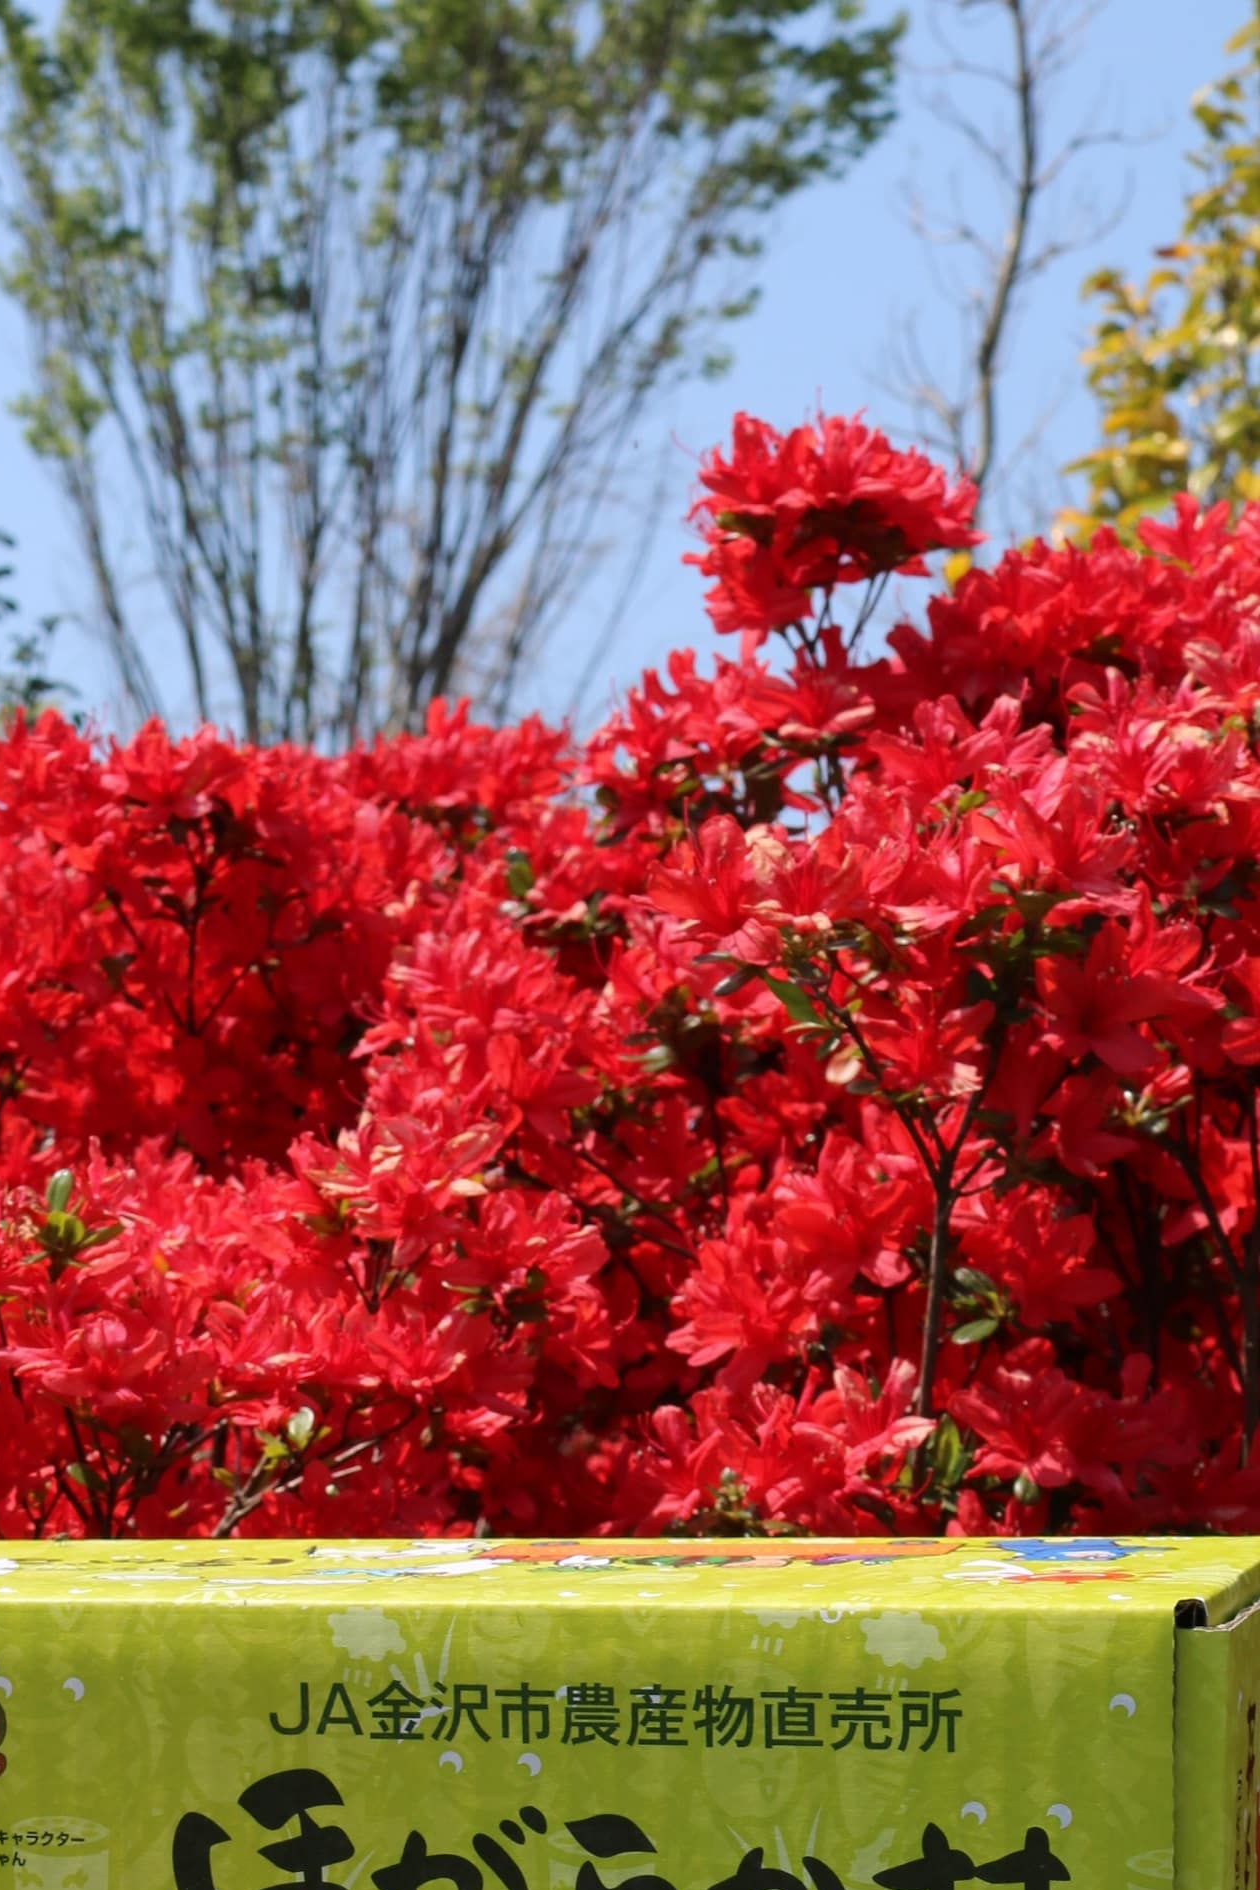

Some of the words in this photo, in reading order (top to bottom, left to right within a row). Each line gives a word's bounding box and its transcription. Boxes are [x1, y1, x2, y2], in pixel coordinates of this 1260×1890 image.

[269, 1680, 963, 1752] JA金沢市農産物直売所
